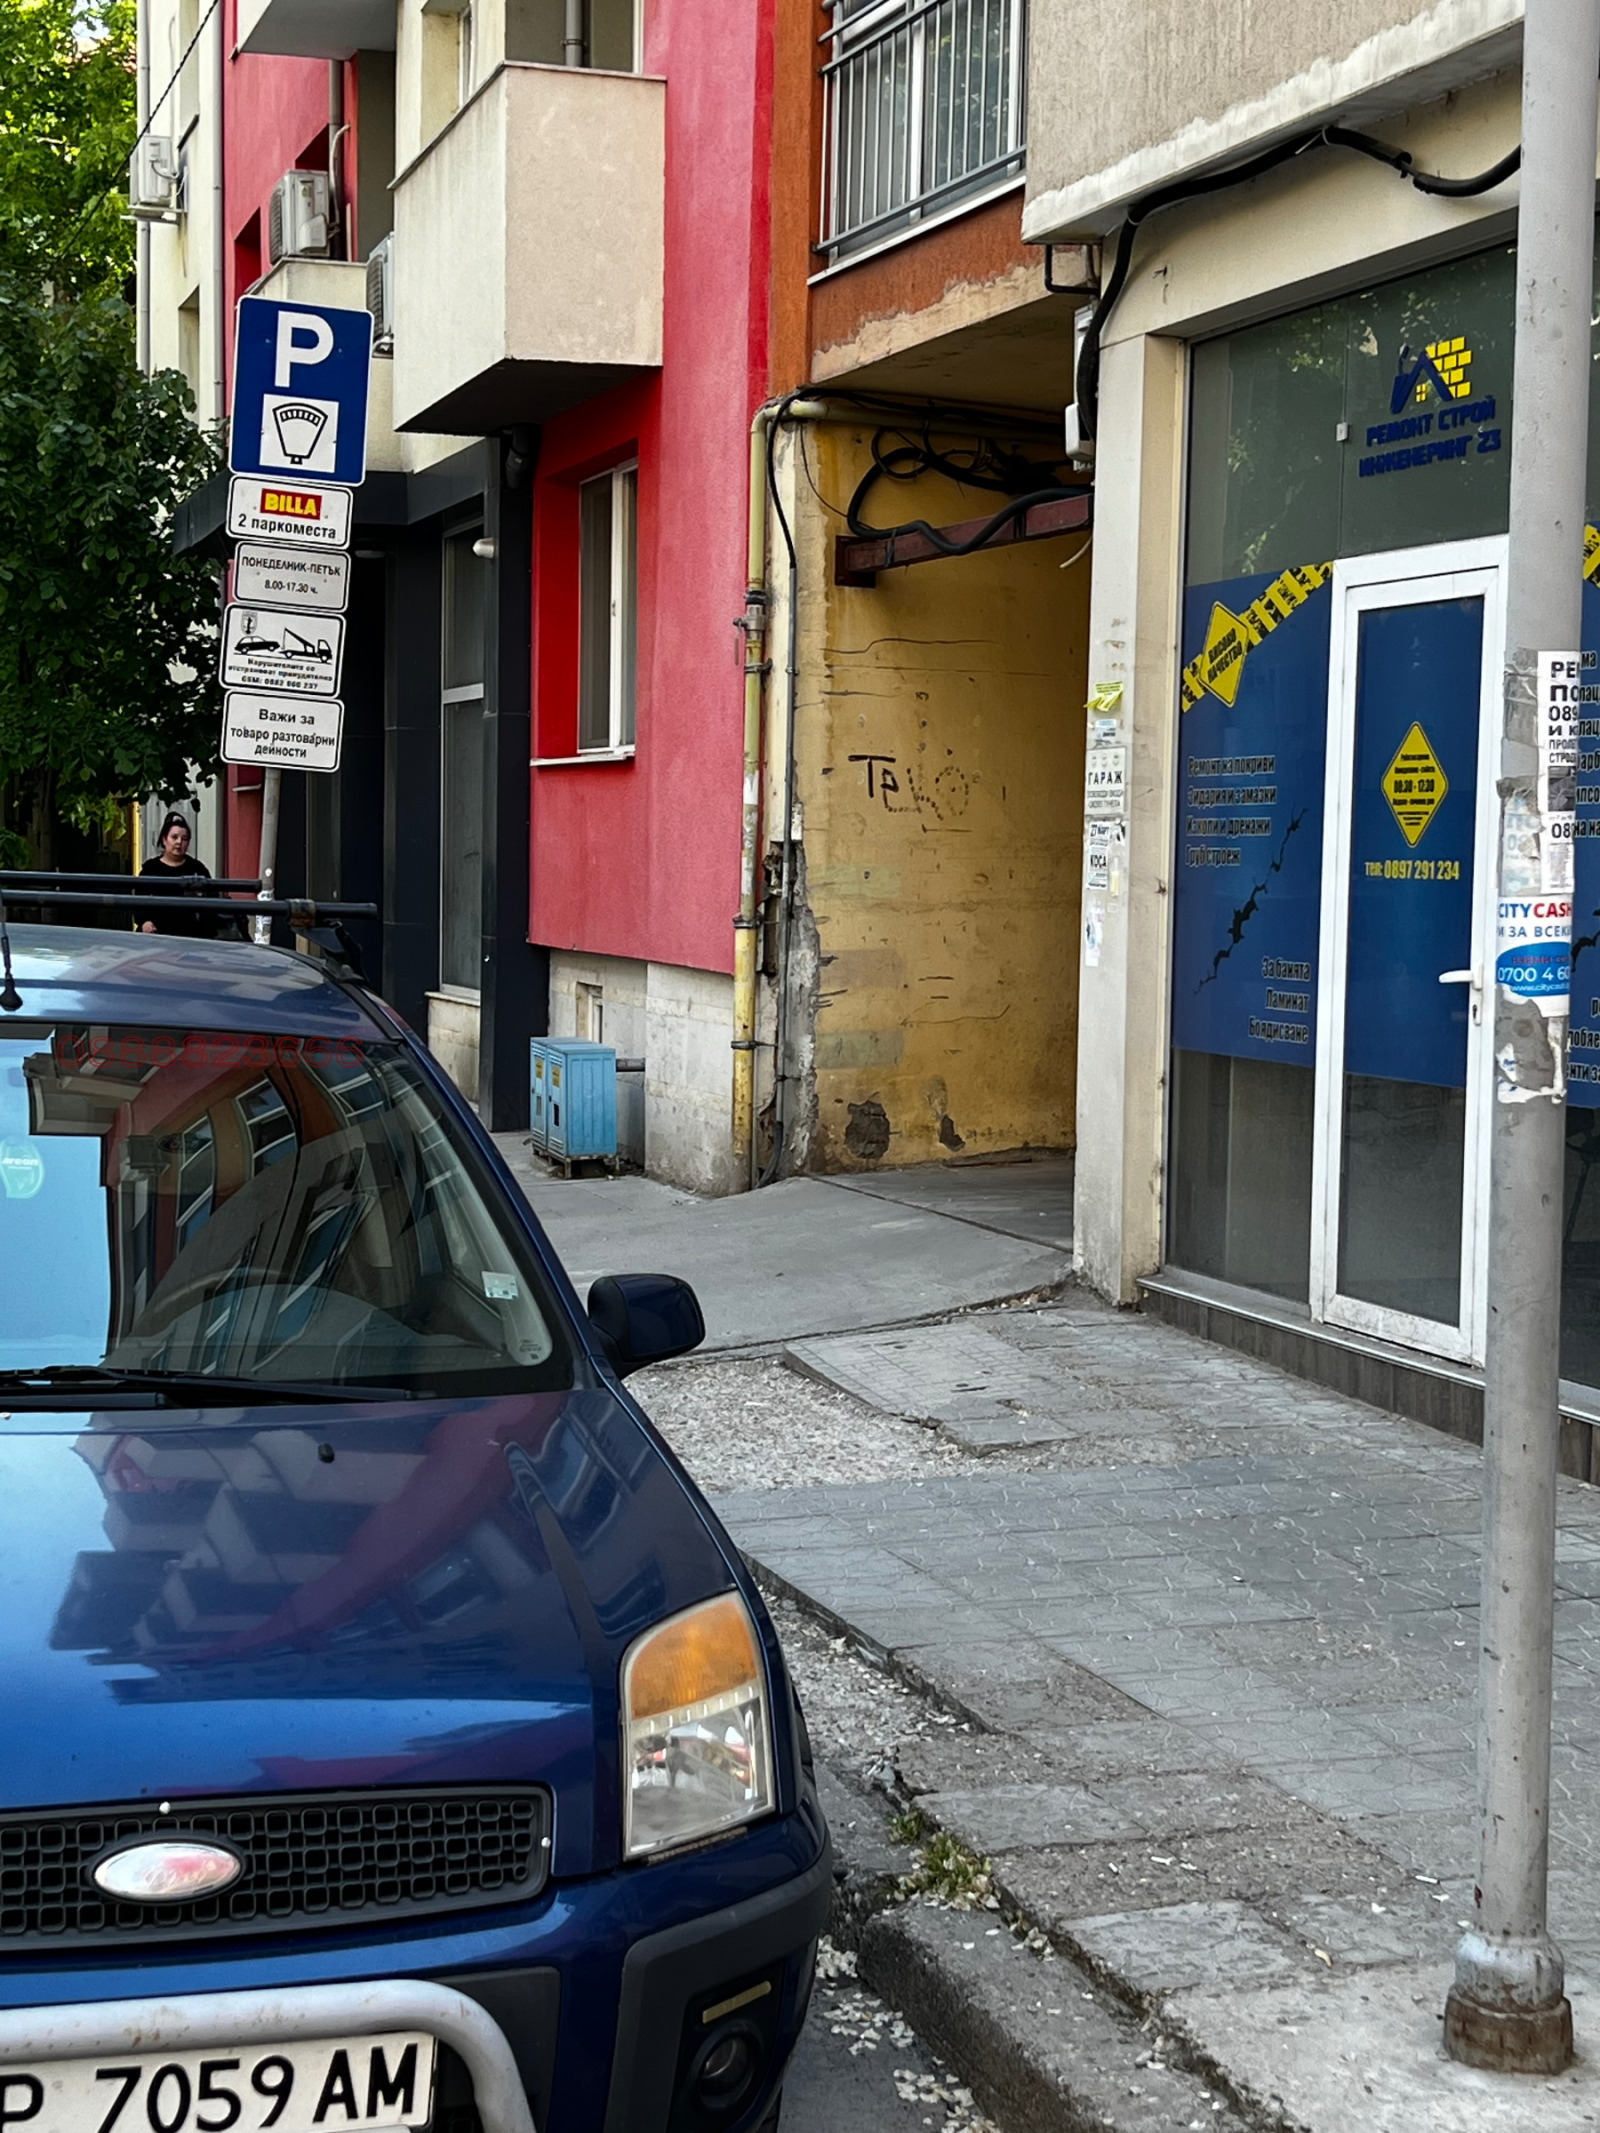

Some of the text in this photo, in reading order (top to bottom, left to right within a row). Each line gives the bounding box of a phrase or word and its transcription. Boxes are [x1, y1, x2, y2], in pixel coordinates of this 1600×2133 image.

[275, 310, 335, 388] P
[1366, 395, 1497, 447] РЕМОНТ СТРОЙ
[1477, 428, 1502, 454] 23
[264, 492, 318, 516] BILLA
[238, 513, 336, 539] 2 паркоместа
[242, 556, 341, 577] ПОНЕДЕЛНИК-ПЕТЪК
[259, 708, 315, 725] Важи за
[230, 726, 335, 747] товаро разтоварни
[254, 743, 307, 758] дейности
[1187, 755, 1276, 777] Ремонт на покриви
[1088, 770, 1122, 785] ГАРАЖ
[1551, 823, 1572, 838] 08
[1384, 860, 1413, 879] 0897
[1414, 860, 1435, 880] 291
[1436, 860, 1460, 880] 234
[1508, 926, 1528, 938] ЗА
[1262, 956, 1311, 982] За банята
[1497, 967, 1538, 982] 0700
[1542, 967, 1555, 981] 4
[1265, 987, 1310, 1013] Ламинат
[1248, 1015, 1309, 1044] Боядисване
[96, 2055, 294, 2133] 7059
[313, 2043, 419, 2125] AM
